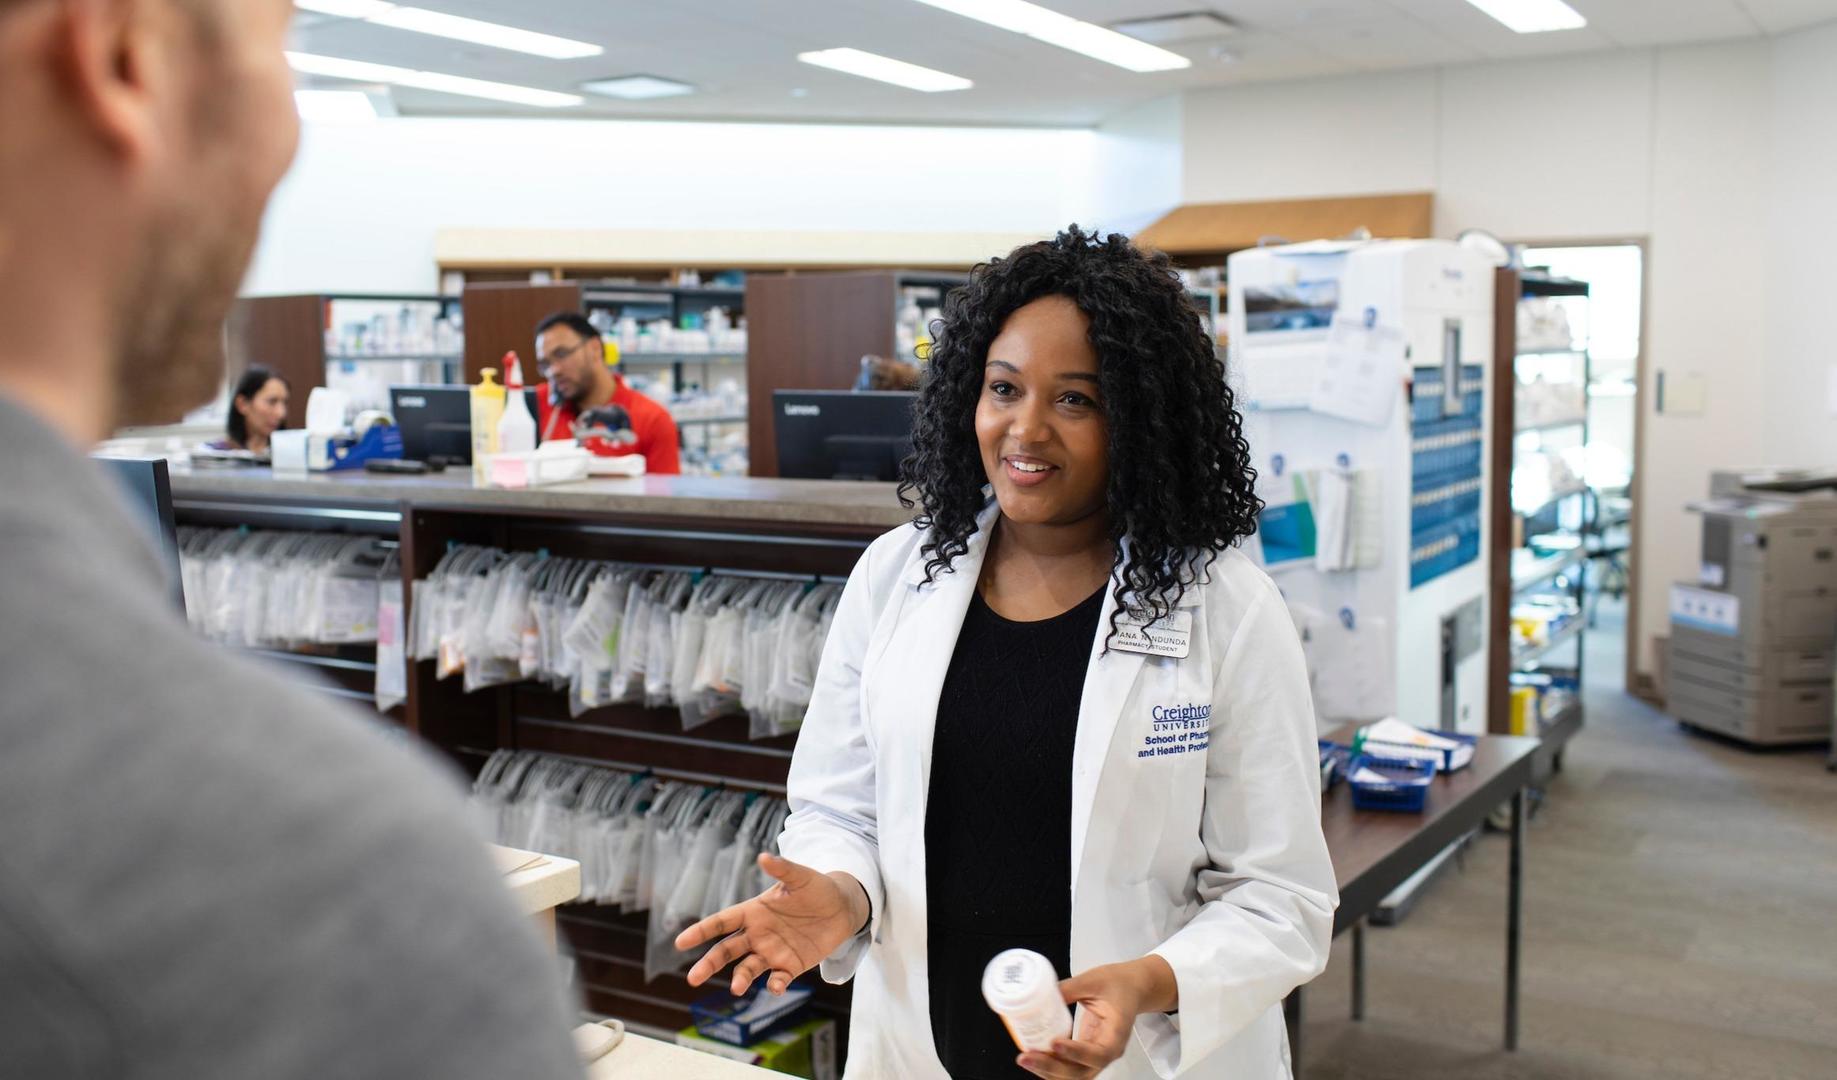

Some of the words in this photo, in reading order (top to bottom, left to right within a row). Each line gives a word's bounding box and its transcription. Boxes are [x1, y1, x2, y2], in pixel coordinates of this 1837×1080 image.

[1152, 635, 1187, 646] NDUNDA
[1145, 735, 1176, 745] School
[1178, 733, 1188, 742] of
[1138, 748, 1154, 758] and
[1157, 745, 1186, 756] Health
